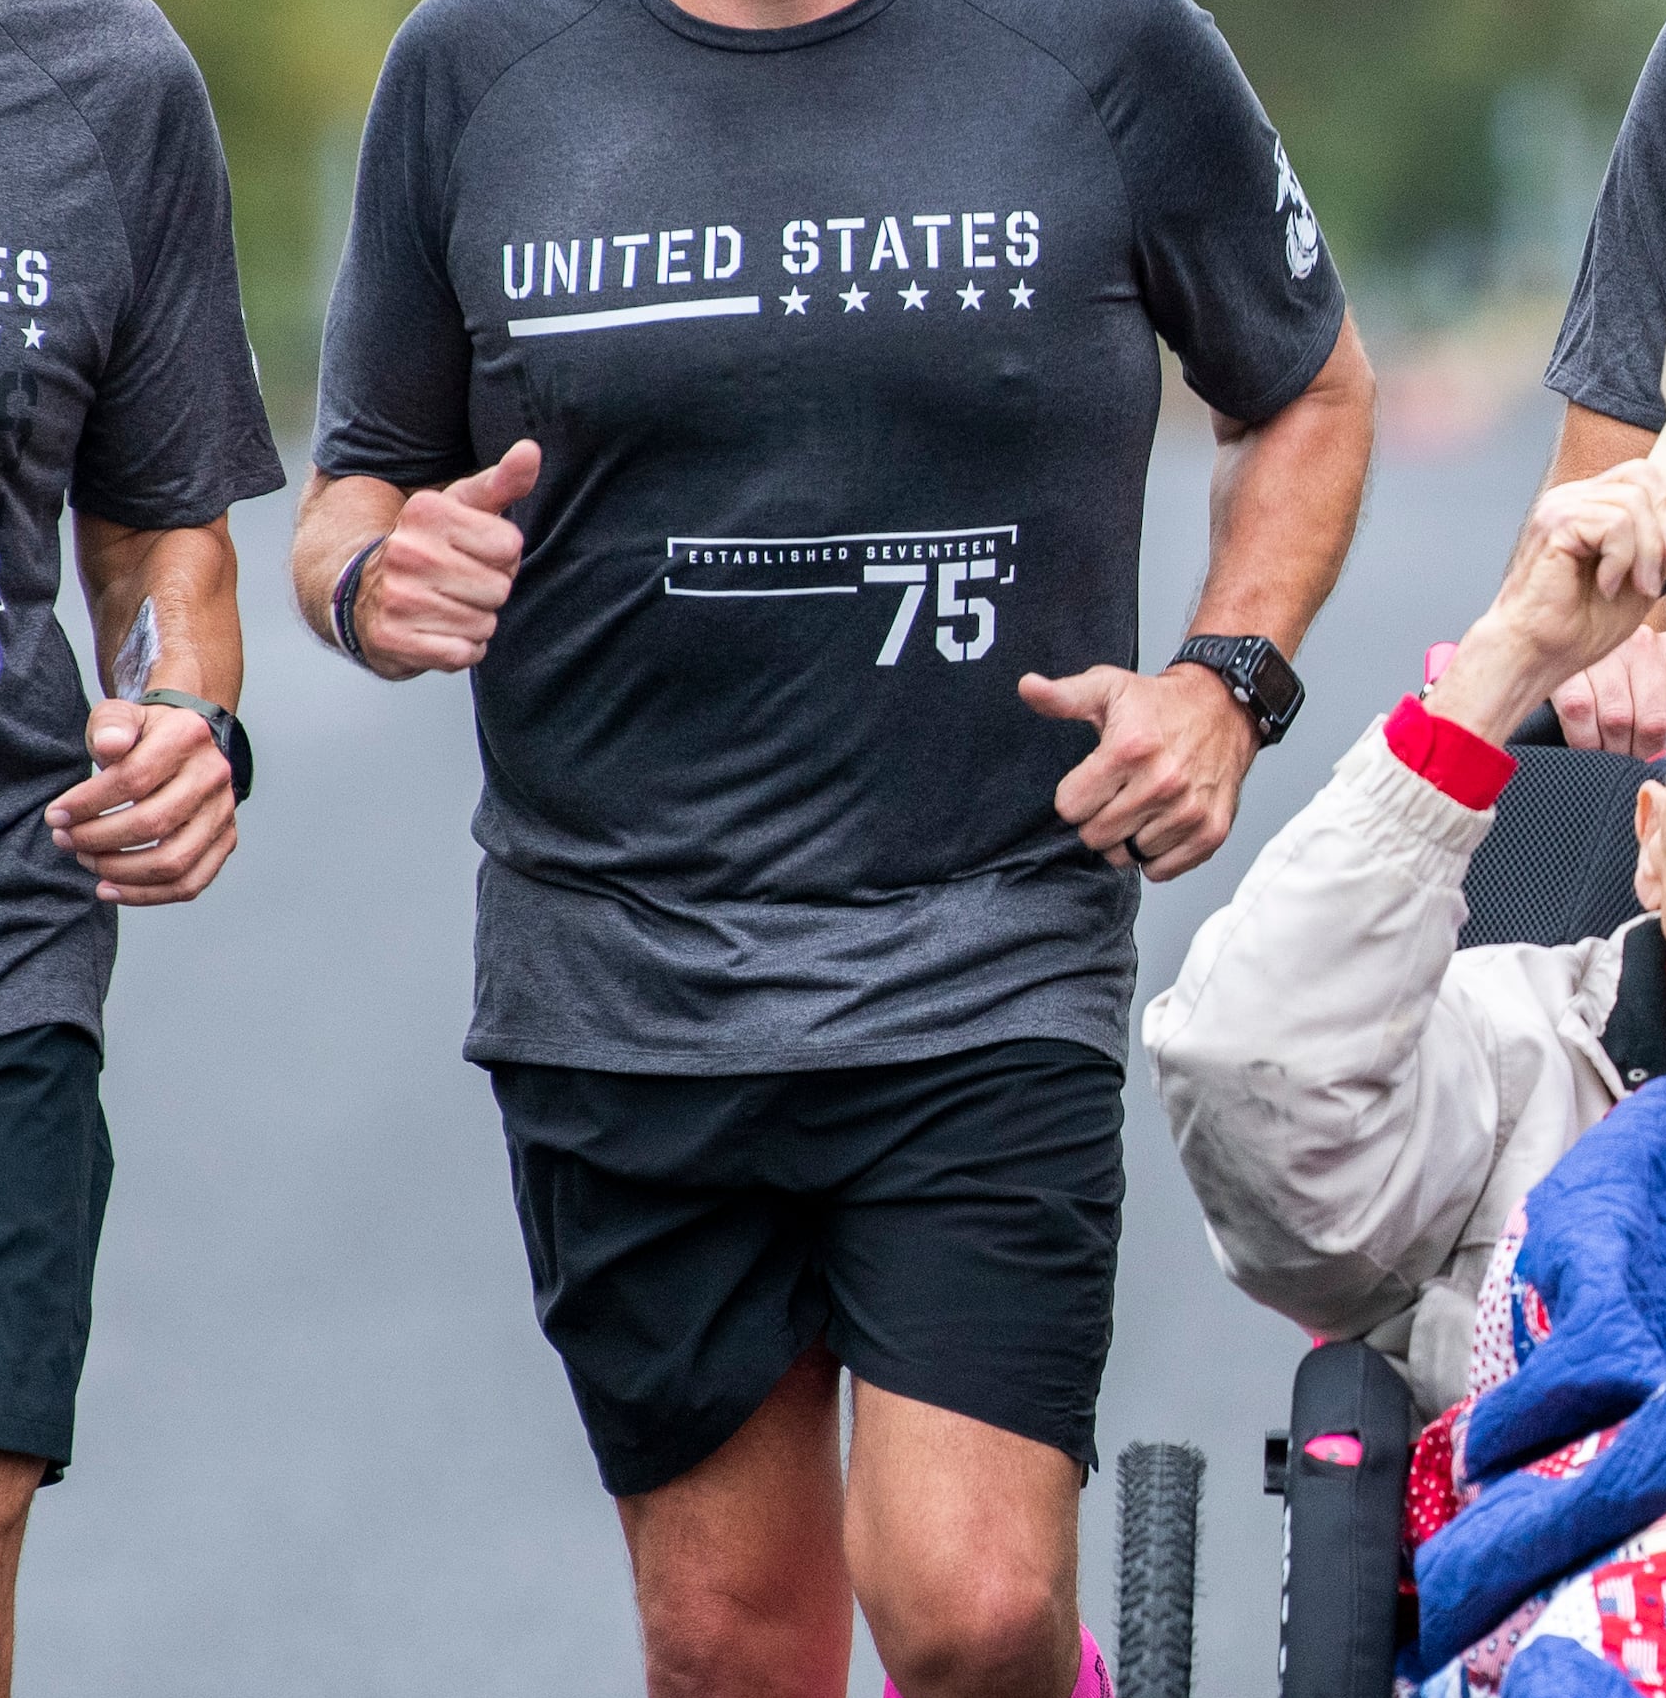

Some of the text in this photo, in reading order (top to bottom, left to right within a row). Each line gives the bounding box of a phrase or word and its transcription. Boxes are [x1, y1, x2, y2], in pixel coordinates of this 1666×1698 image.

[503, 210, 1041, 299] UNITED STATES
[688, 539, 996, 564] ESTABLISHED SEVENTEEN
[863, 558, 996, 666] 75
